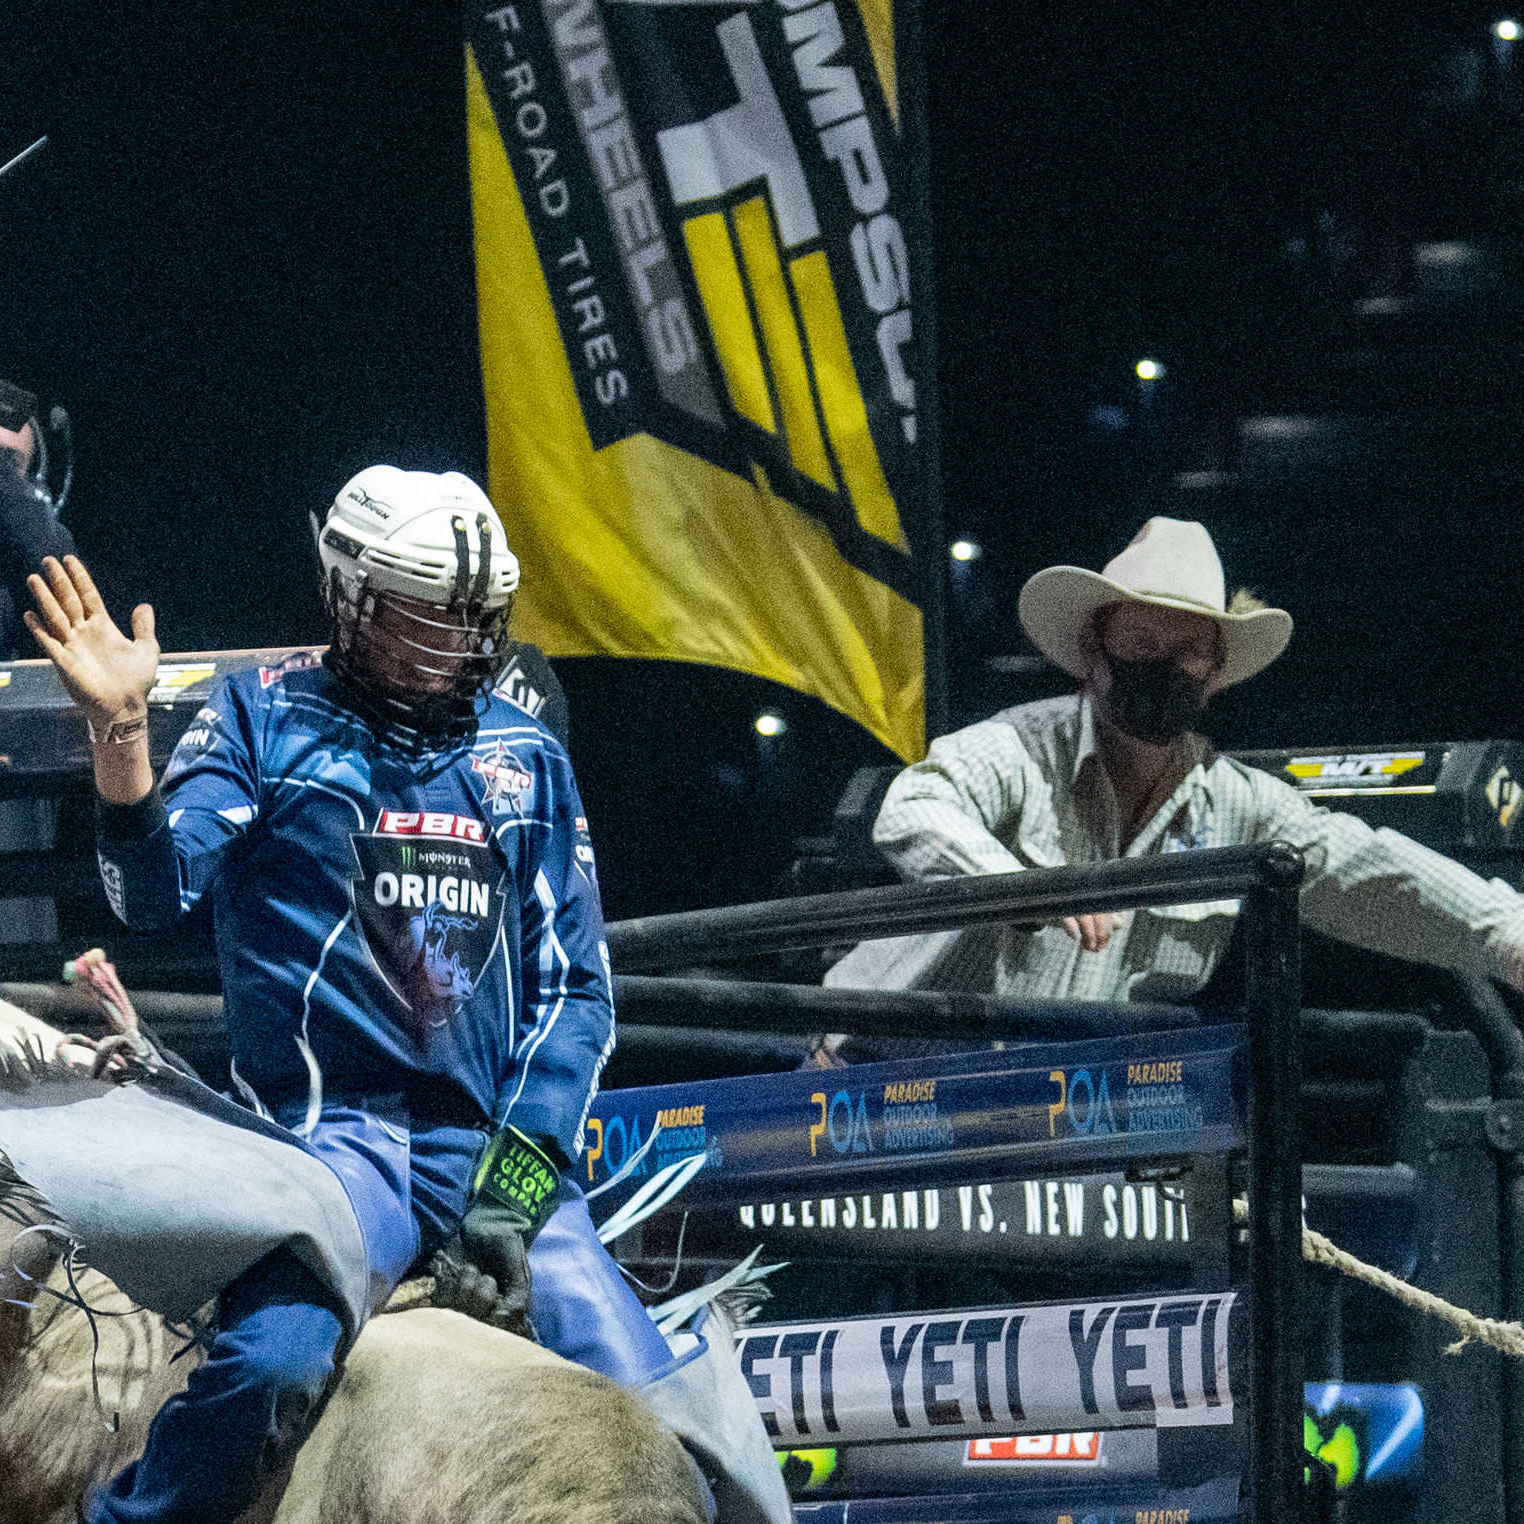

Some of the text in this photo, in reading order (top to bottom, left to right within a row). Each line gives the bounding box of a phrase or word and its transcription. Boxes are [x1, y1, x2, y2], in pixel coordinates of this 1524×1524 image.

[559, 237, 629, 405] TIRES
[384, 811, 484, 842] PBR
[374, 872, 490, 917] ORIGIN
[884, 1080, 936, 1104] PARADISE
[1127, 1061, 1182, 1085] PARADISE
[959, 1184, 1007, 1234] VS.
[1023, 1180, 1084, 1236] NEW
[734, 1299, 1222, 1436] ETI YETI YETI
